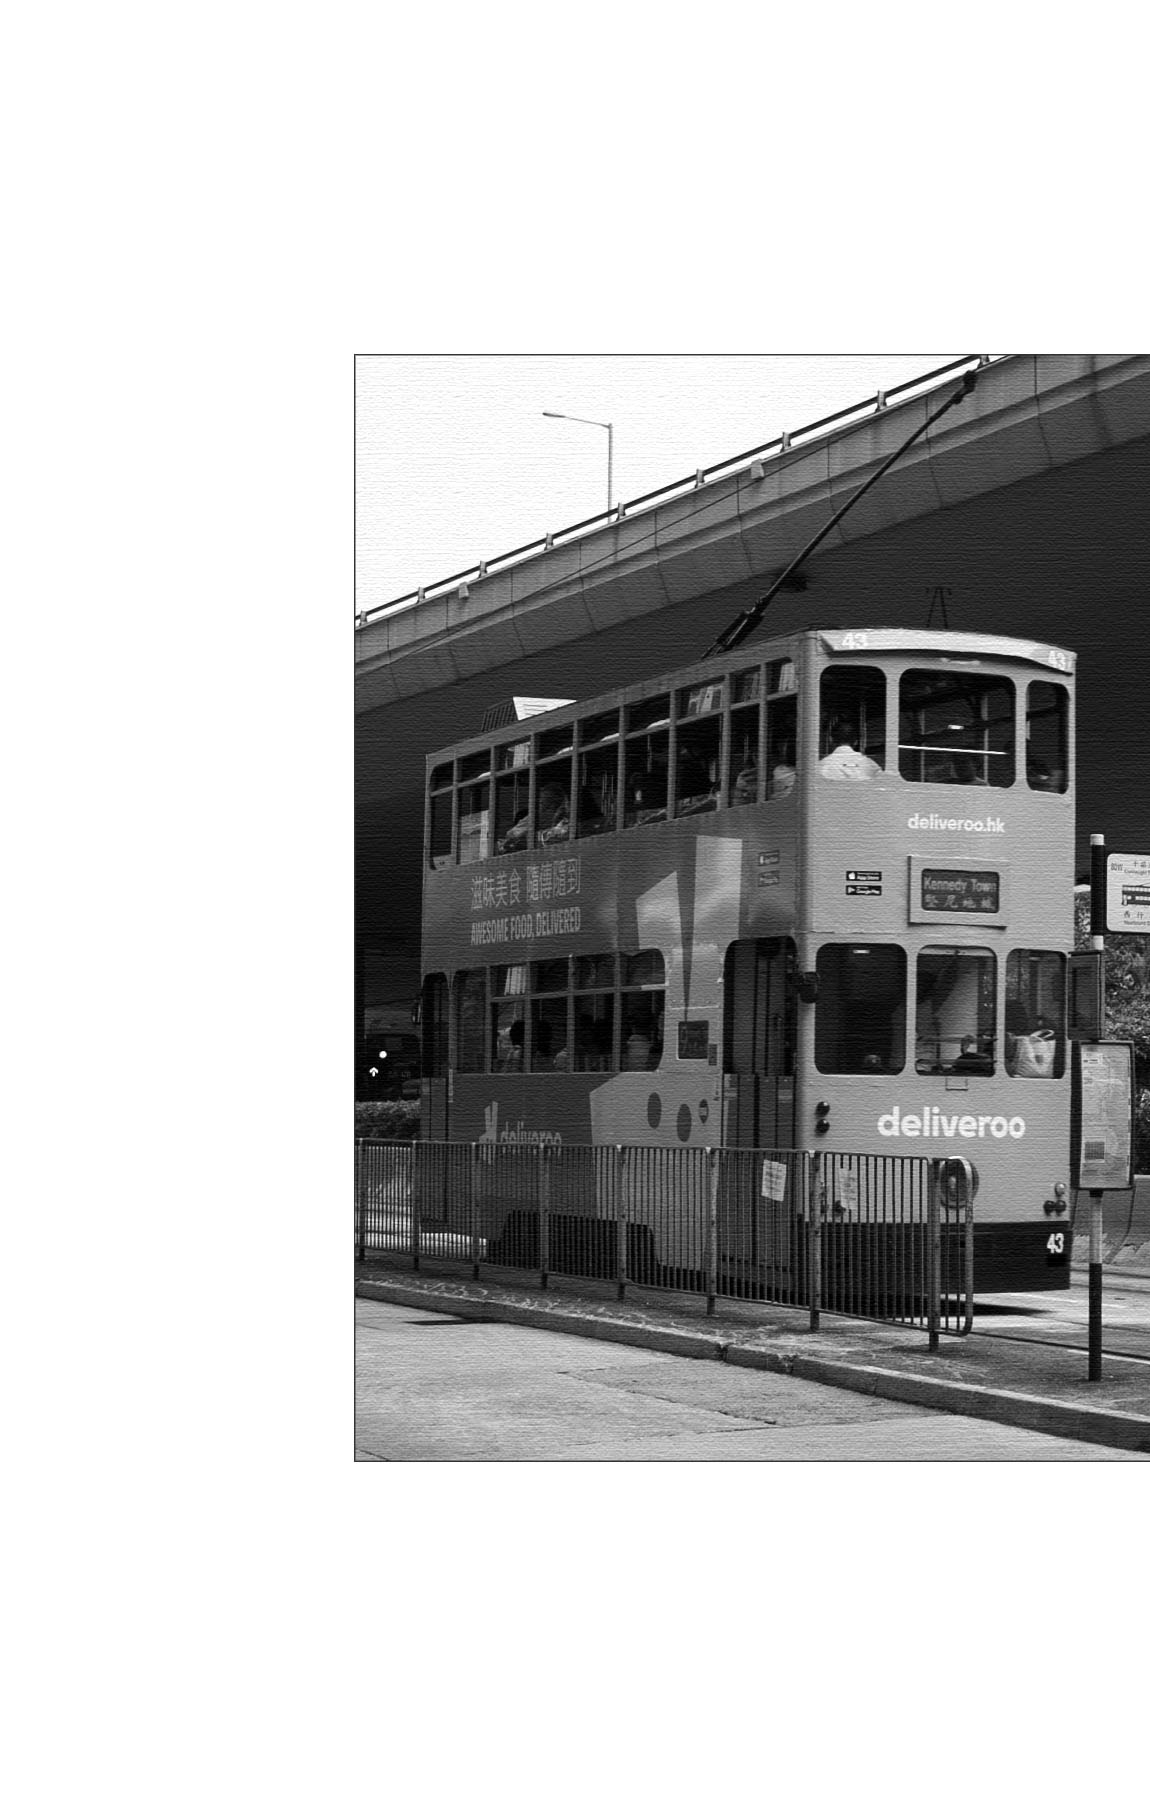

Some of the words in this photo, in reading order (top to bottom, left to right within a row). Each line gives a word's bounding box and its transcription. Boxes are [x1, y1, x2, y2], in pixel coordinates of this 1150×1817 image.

[841, 632, 867, 648] 43
[907, 813, 1006, 833] deliveroo.hk
[923, 876, 968, 894] Kennedy
[970, 878, 998, 893] Town
[470, 917, 509, 946] AWESOME
[536, 906, 581, 937] DELIVERED
[877, 1105, 1026, 1139] deliveroo
[1046, 1233, 1065, 1254] 43
